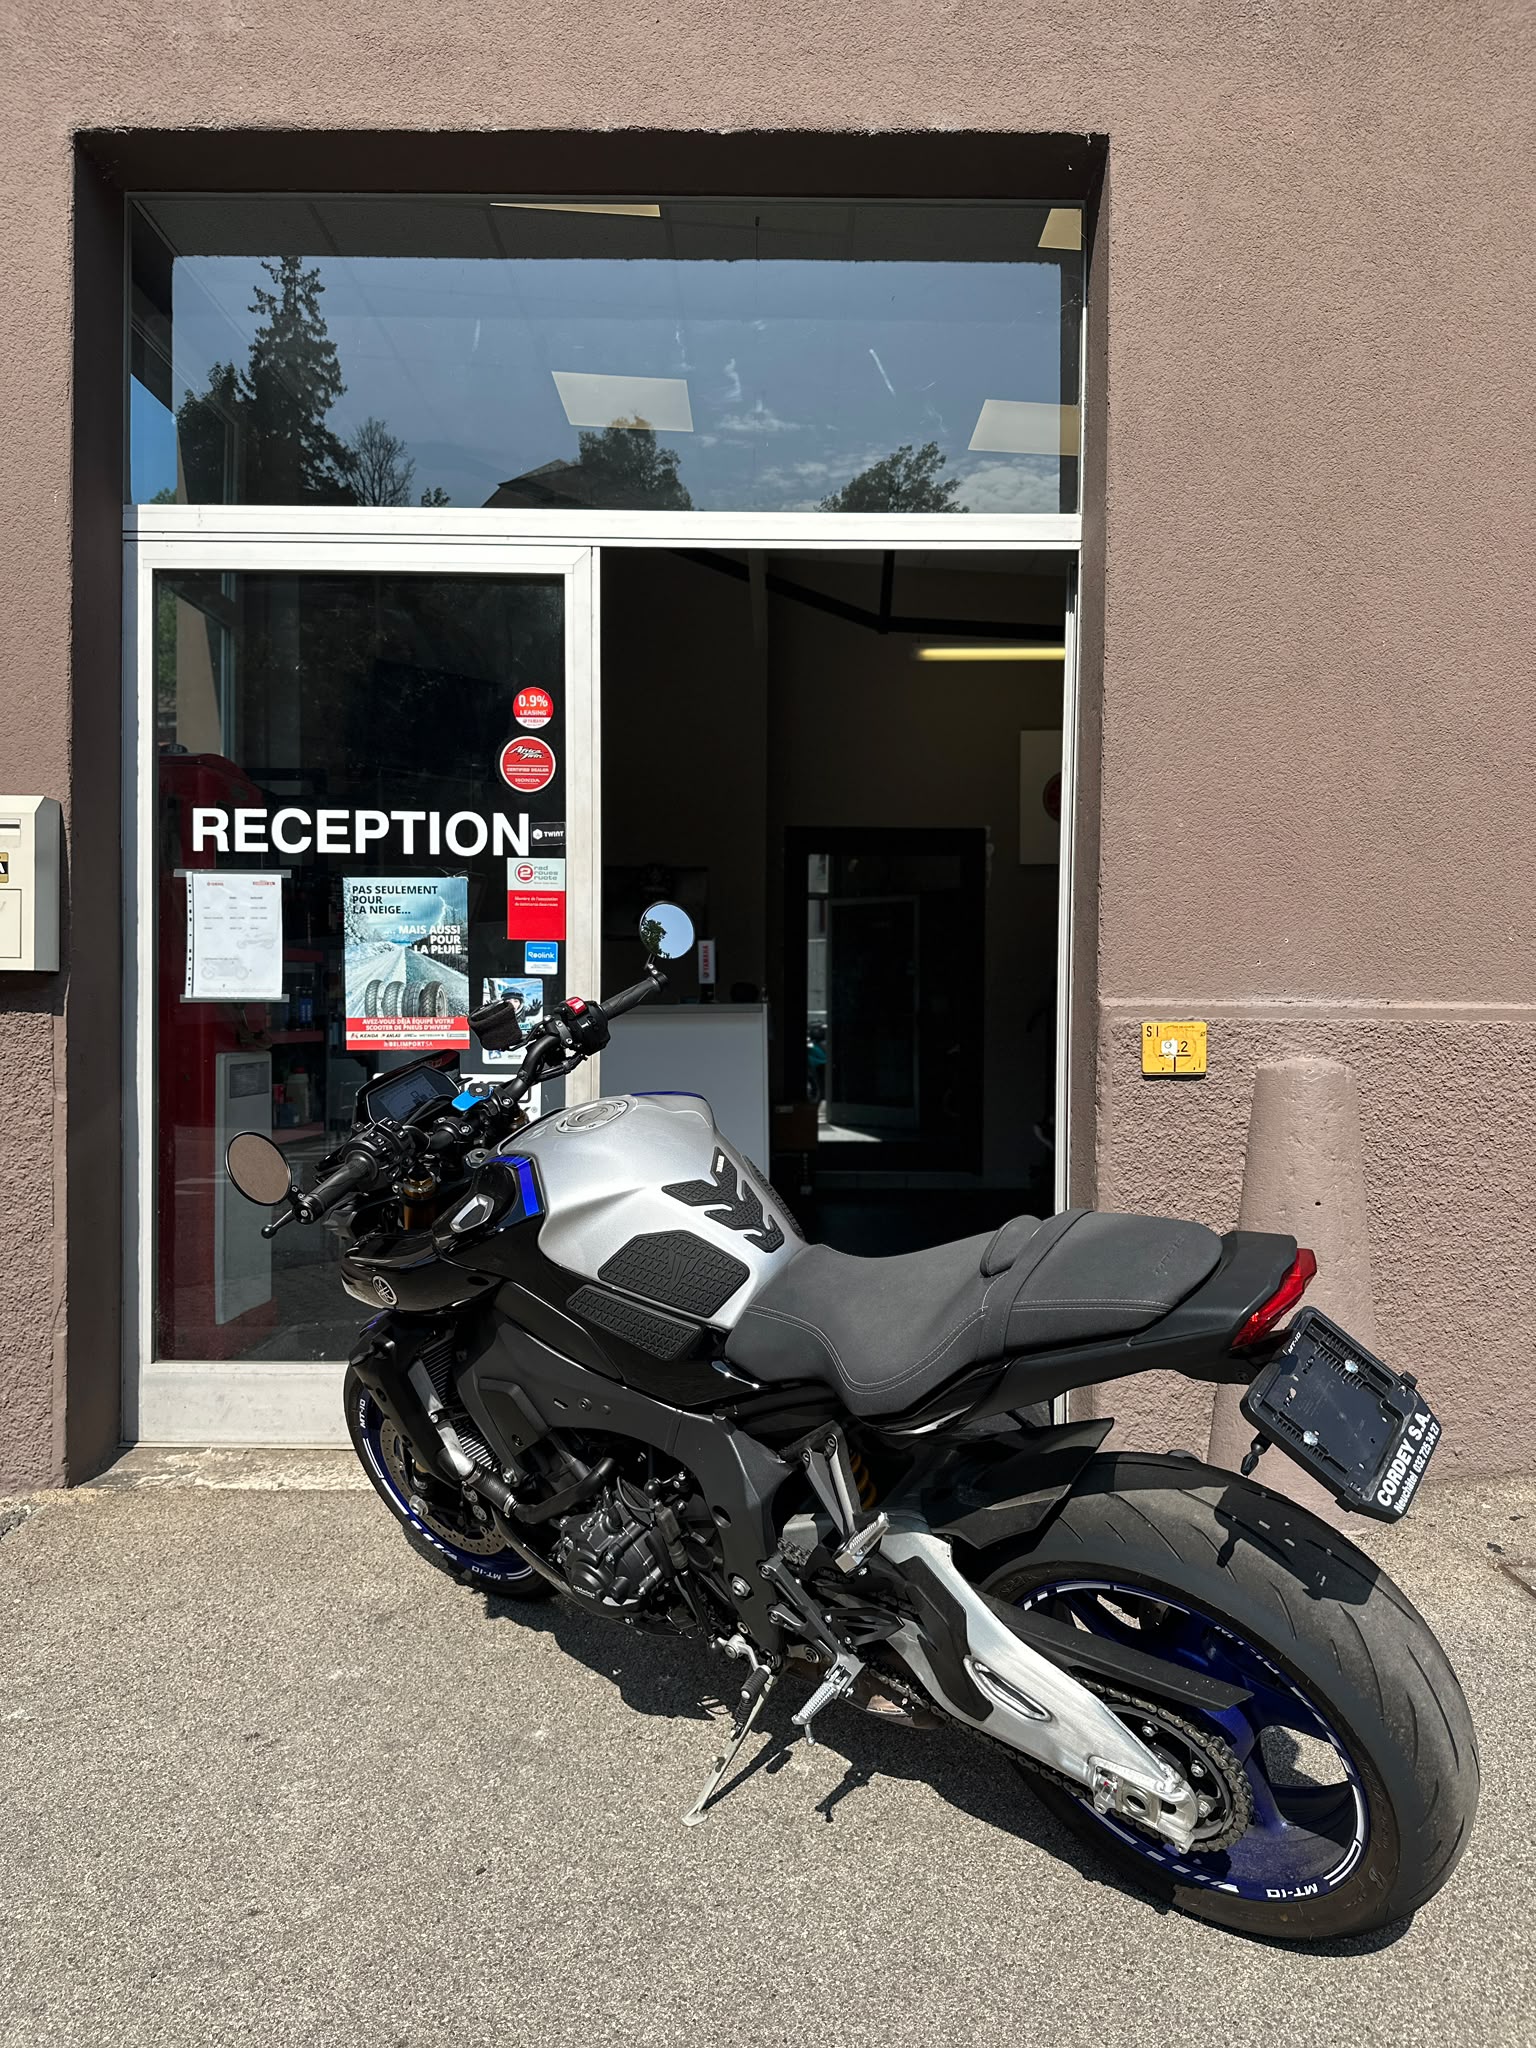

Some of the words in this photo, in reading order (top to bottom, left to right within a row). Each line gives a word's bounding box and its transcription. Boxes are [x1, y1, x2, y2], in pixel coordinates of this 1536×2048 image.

[518, 694, 548, 707] 0.9%
[192, 808, 529, 857] RECEPTION
[352, 885, 372, 894] PAS
[375, 885, 438, 895] SEULEMENT
[352, 895, 383, 904] POUR
[352, 906, 367, 914] LA
[369, 905, 411, 914] NEIGE...
[399, 925, 427, 934] MAIS
[429, 925, 460, 935] AUSSI
[430, 935, 461, 944] POUR
[414, 945, 429, 954] LA
[431, 945, 461, 954] PLUIE
[1377, 1437, 1415, 1507] CORDEY
[1407, 1412, 1431, 1441] S.A.
[1393, 1470, 1418, 1514] Neuchâtel
[1412, 1456, 1426, 1473] 032
[471, 1565, 501, 1580] MT-10
[1265, 1883, 1318, 1898] MT-10
